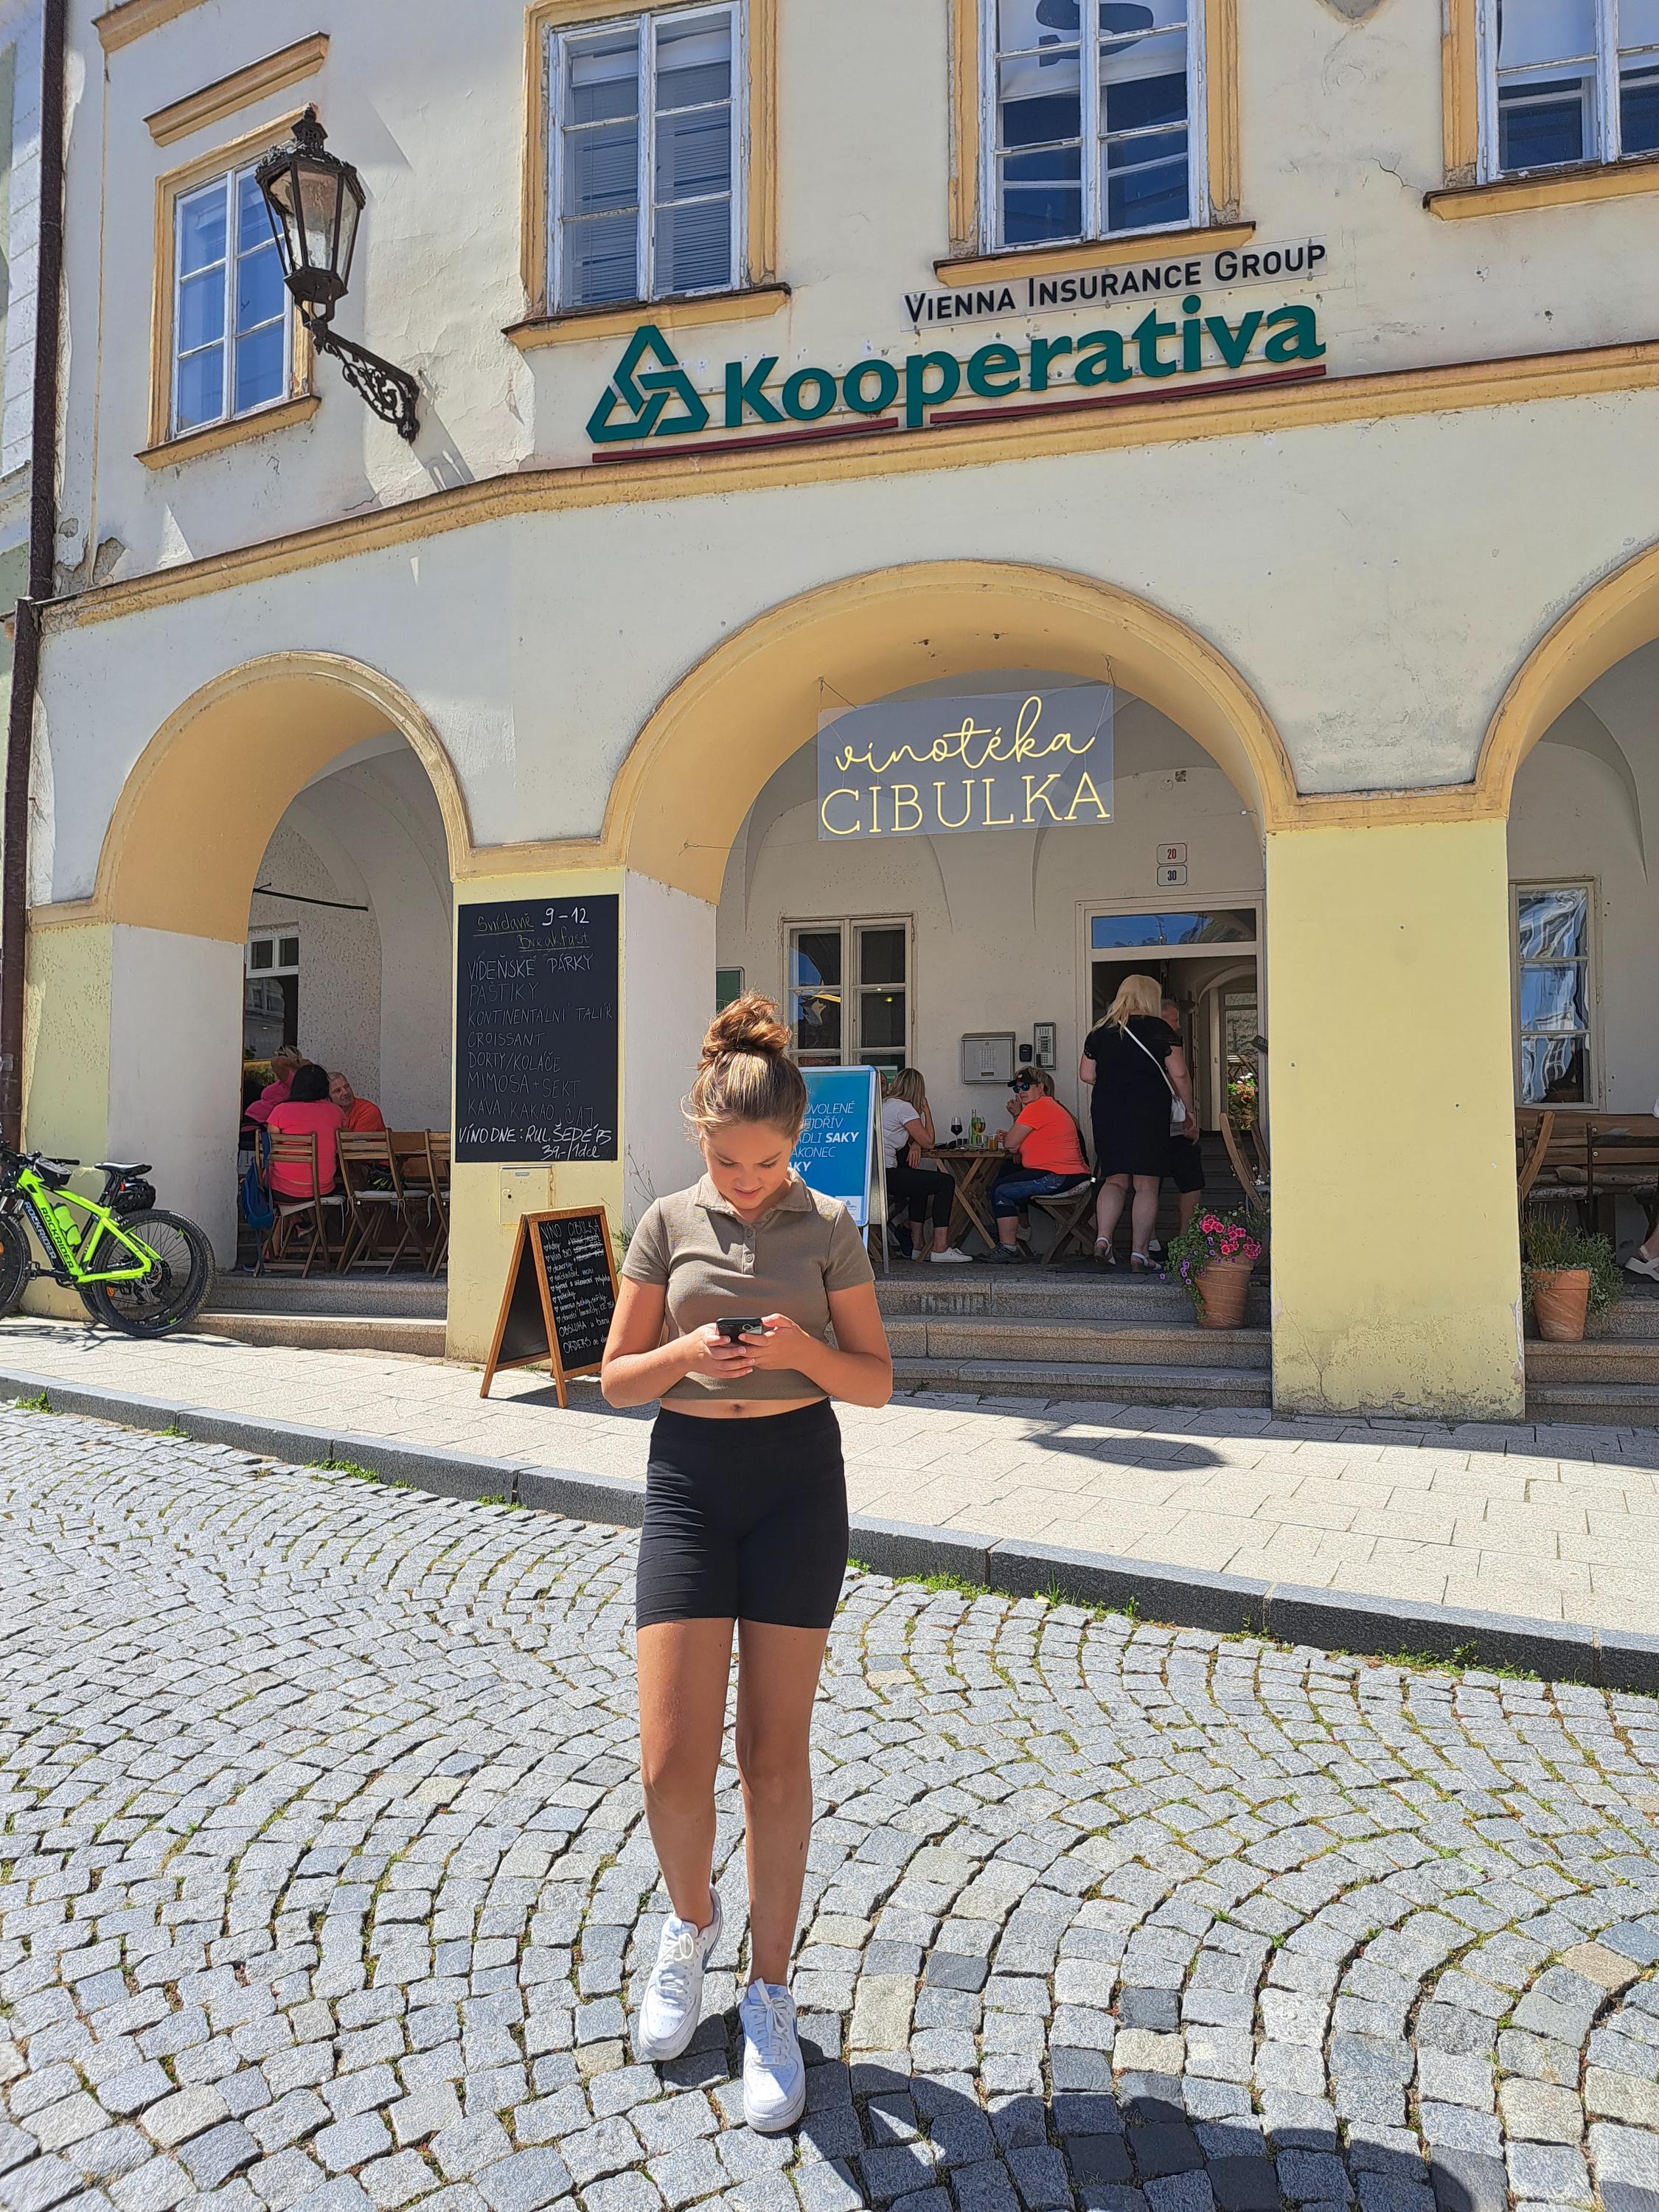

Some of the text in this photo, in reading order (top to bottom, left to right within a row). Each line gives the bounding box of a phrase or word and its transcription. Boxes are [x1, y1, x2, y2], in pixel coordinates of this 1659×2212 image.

[906, 245, 1326, 323] VIENNA INSURANCE GROUP
[725, 295, 1326, 428] Kooperativa
[835, 695, 1096, 773] vinotéka
[821, 771, 1110, 835] CIBULKA
[1167, 849, 1177, 860] 20
[1167, 870, 1177, 881] 30
[518, 926, 589, 949] Breakfast
[546, 953, 594, 973] PÁRKY
[470, 980, 538, 1006] PAŠTIKY
[467, 1032, 546, 1048] CROISSANT
[467, 1072, 529, 1094] MIMOSA
[543, 1078, 581, 1098] SEKT
[802, 1116, 844, 1130] EJDŘÍV
[826, 1132, 859, 1143] SAKY
[791, 1147, 837, 1158] AKONEC
[24, 1201, 57, 1259] ROCKRIDER
[41, 1207, 74, 1268] ROCKRIDER
